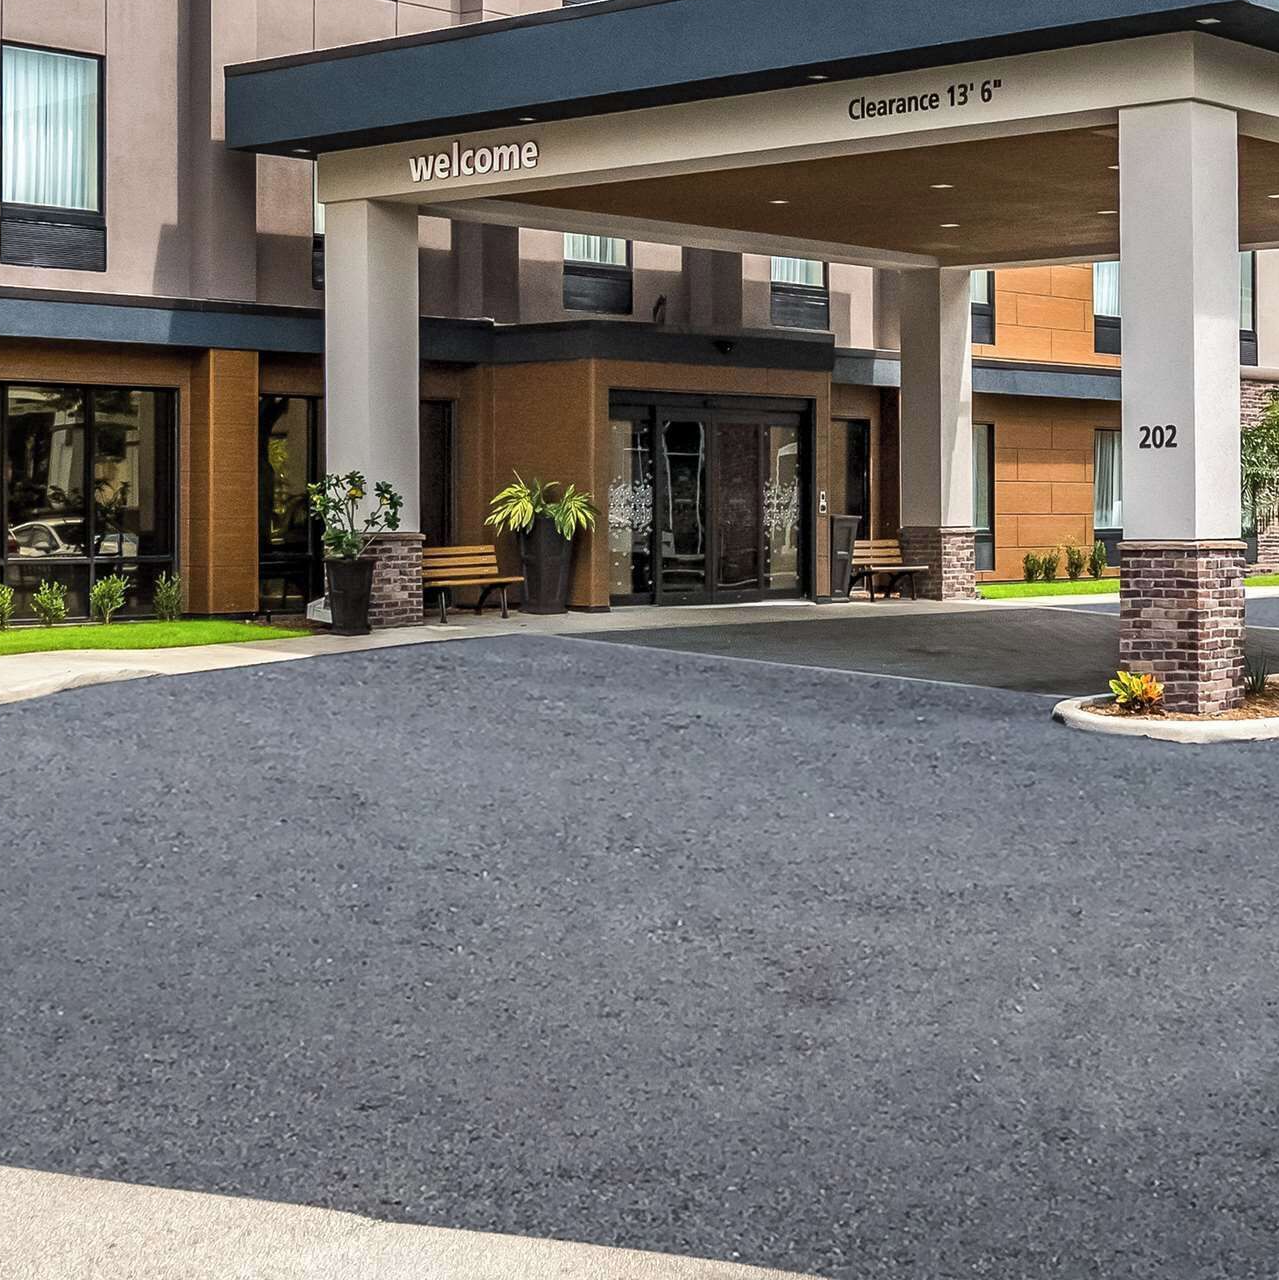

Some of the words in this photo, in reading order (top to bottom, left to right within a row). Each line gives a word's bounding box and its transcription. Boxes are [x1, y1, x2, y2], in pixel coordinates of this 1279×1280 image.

[847, 92, 940, 120] Clearance
[409, 140, 539, 182] welcome
[1139, 424, 1177, 449] 202
